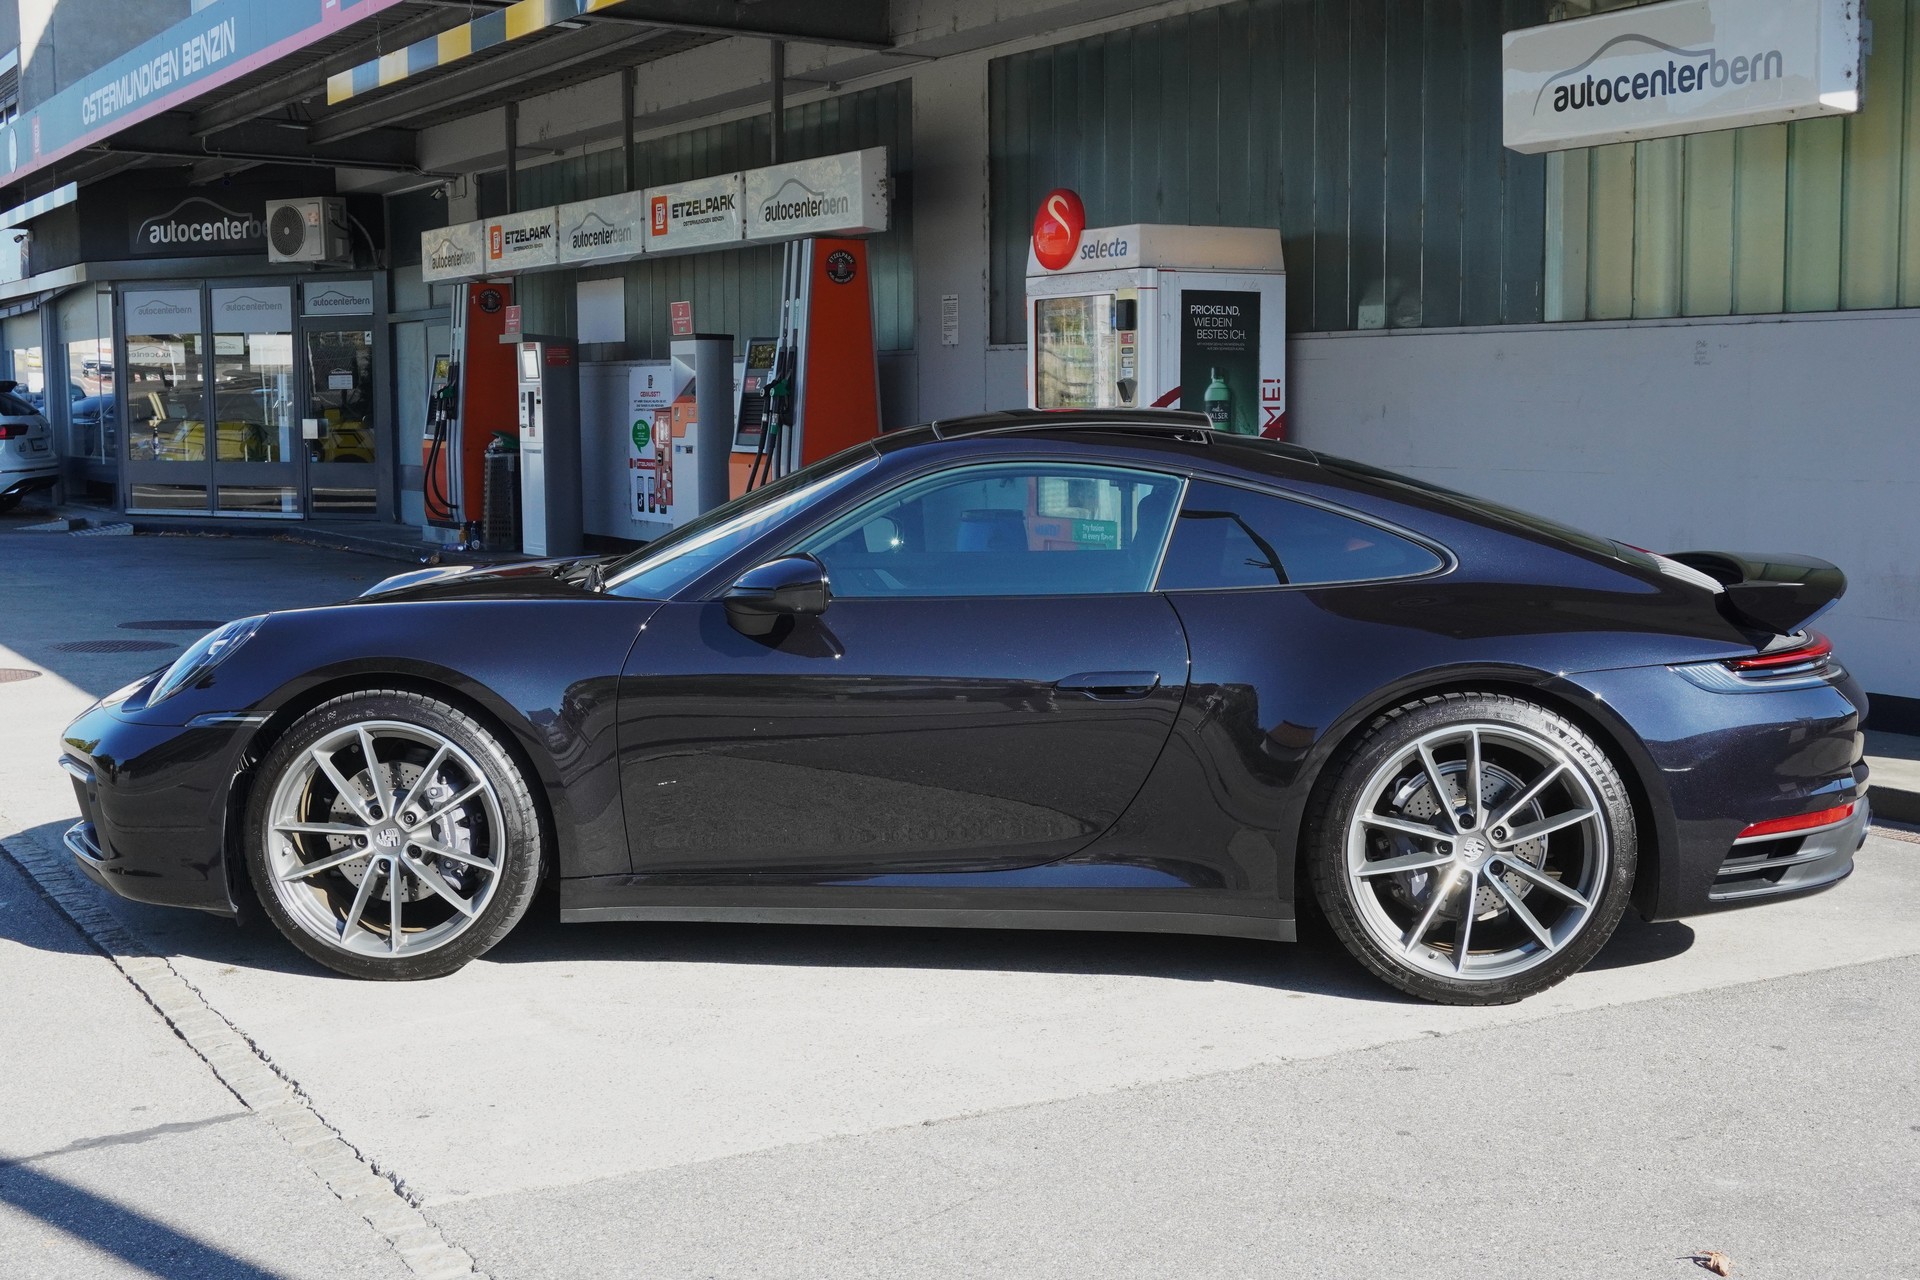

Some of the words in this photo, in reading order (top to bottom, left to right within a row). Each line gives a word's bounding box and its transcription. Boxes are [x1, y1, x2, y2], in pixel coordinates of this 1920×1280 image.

[82, 51, 179, 126] OSTERMUNDIGEN
[182, 17, 236, 76] BENZIN
[1553, 49, 1783, 113] autocenterbern
[672, 194, 735, 218] ETZELPARK
[765, 194, 848, 222] autocenterbern
[505, 224, 551, 245] ETZELPARK
[572, 224, 631, 249] autocenterbern
[1080, 237, 1128, 260] selecta
[225, 301, 283, 311] autocenterbern
[312, 295, 370, 306] autocenterbern
[138, 305, 192, 315] autocenterbern
[1190, 304, 1240, 316] PRICKELND,
[1193, 317, 1211, 327] WIE
[1212, 317, 1233, 327] DEIN
[1196, 329, 1228, 340] BESTES
[1229, 329, 1247, 340] ICH.
[756, 377, 761, 389] 2
[1082, 524, 1090, 533] Try
[1090, 523, 1104, 531] fusion
[1562, 735, 1614, 798] MICHELIN
